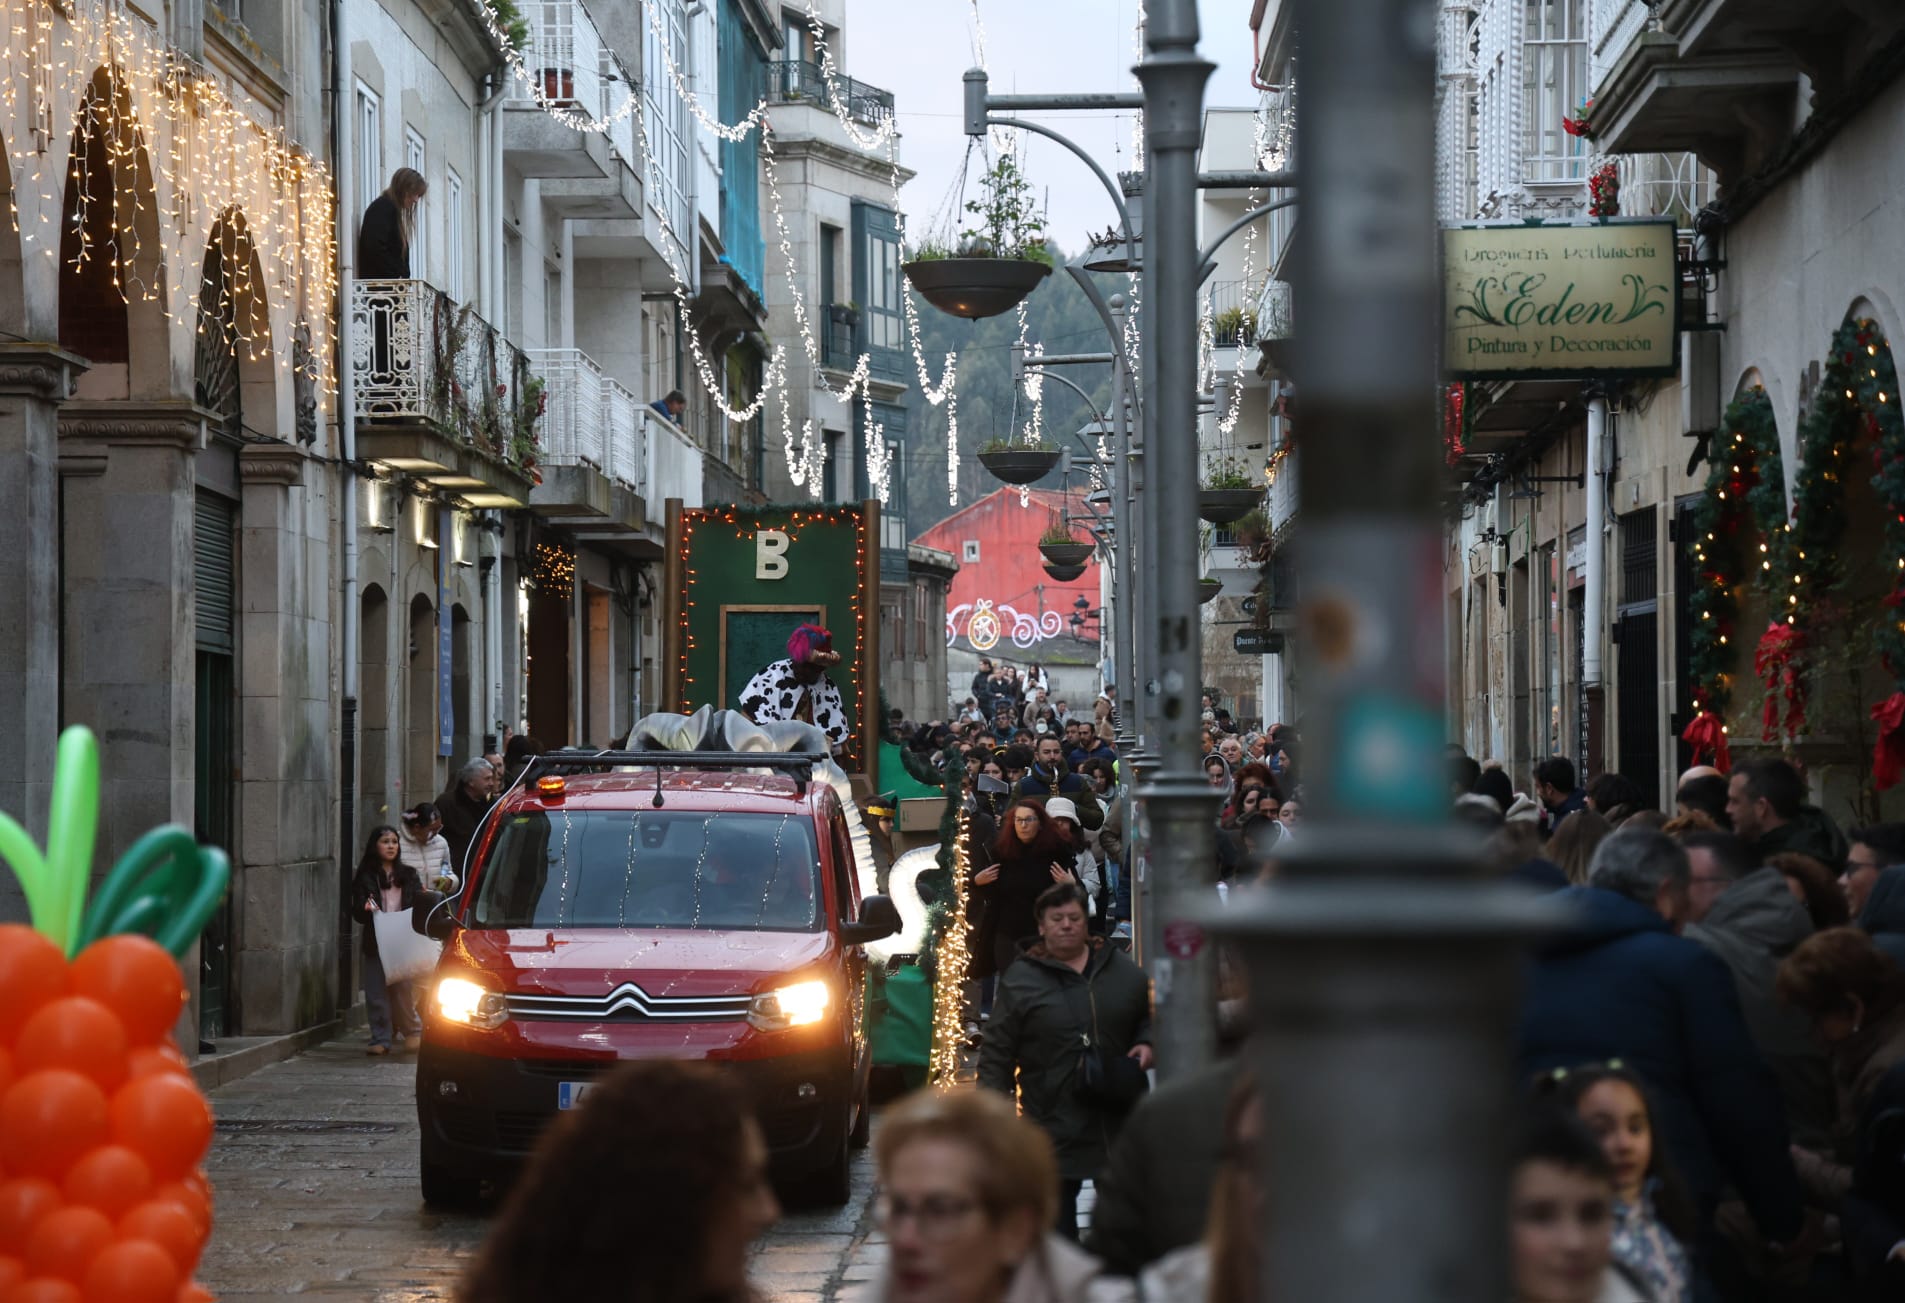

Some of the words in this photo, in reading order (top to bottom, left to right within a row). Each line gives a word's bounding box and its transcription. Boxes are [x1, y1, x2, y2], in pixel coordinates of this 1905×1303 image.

[1503, 271, 1618, 331] Eden
[1467, 336, 1528, 354] Pintura
[1533, 340, 1544, 357] y
[1550, 335, 1652, 353] Decoración
[756, 530, 790, 580] B
